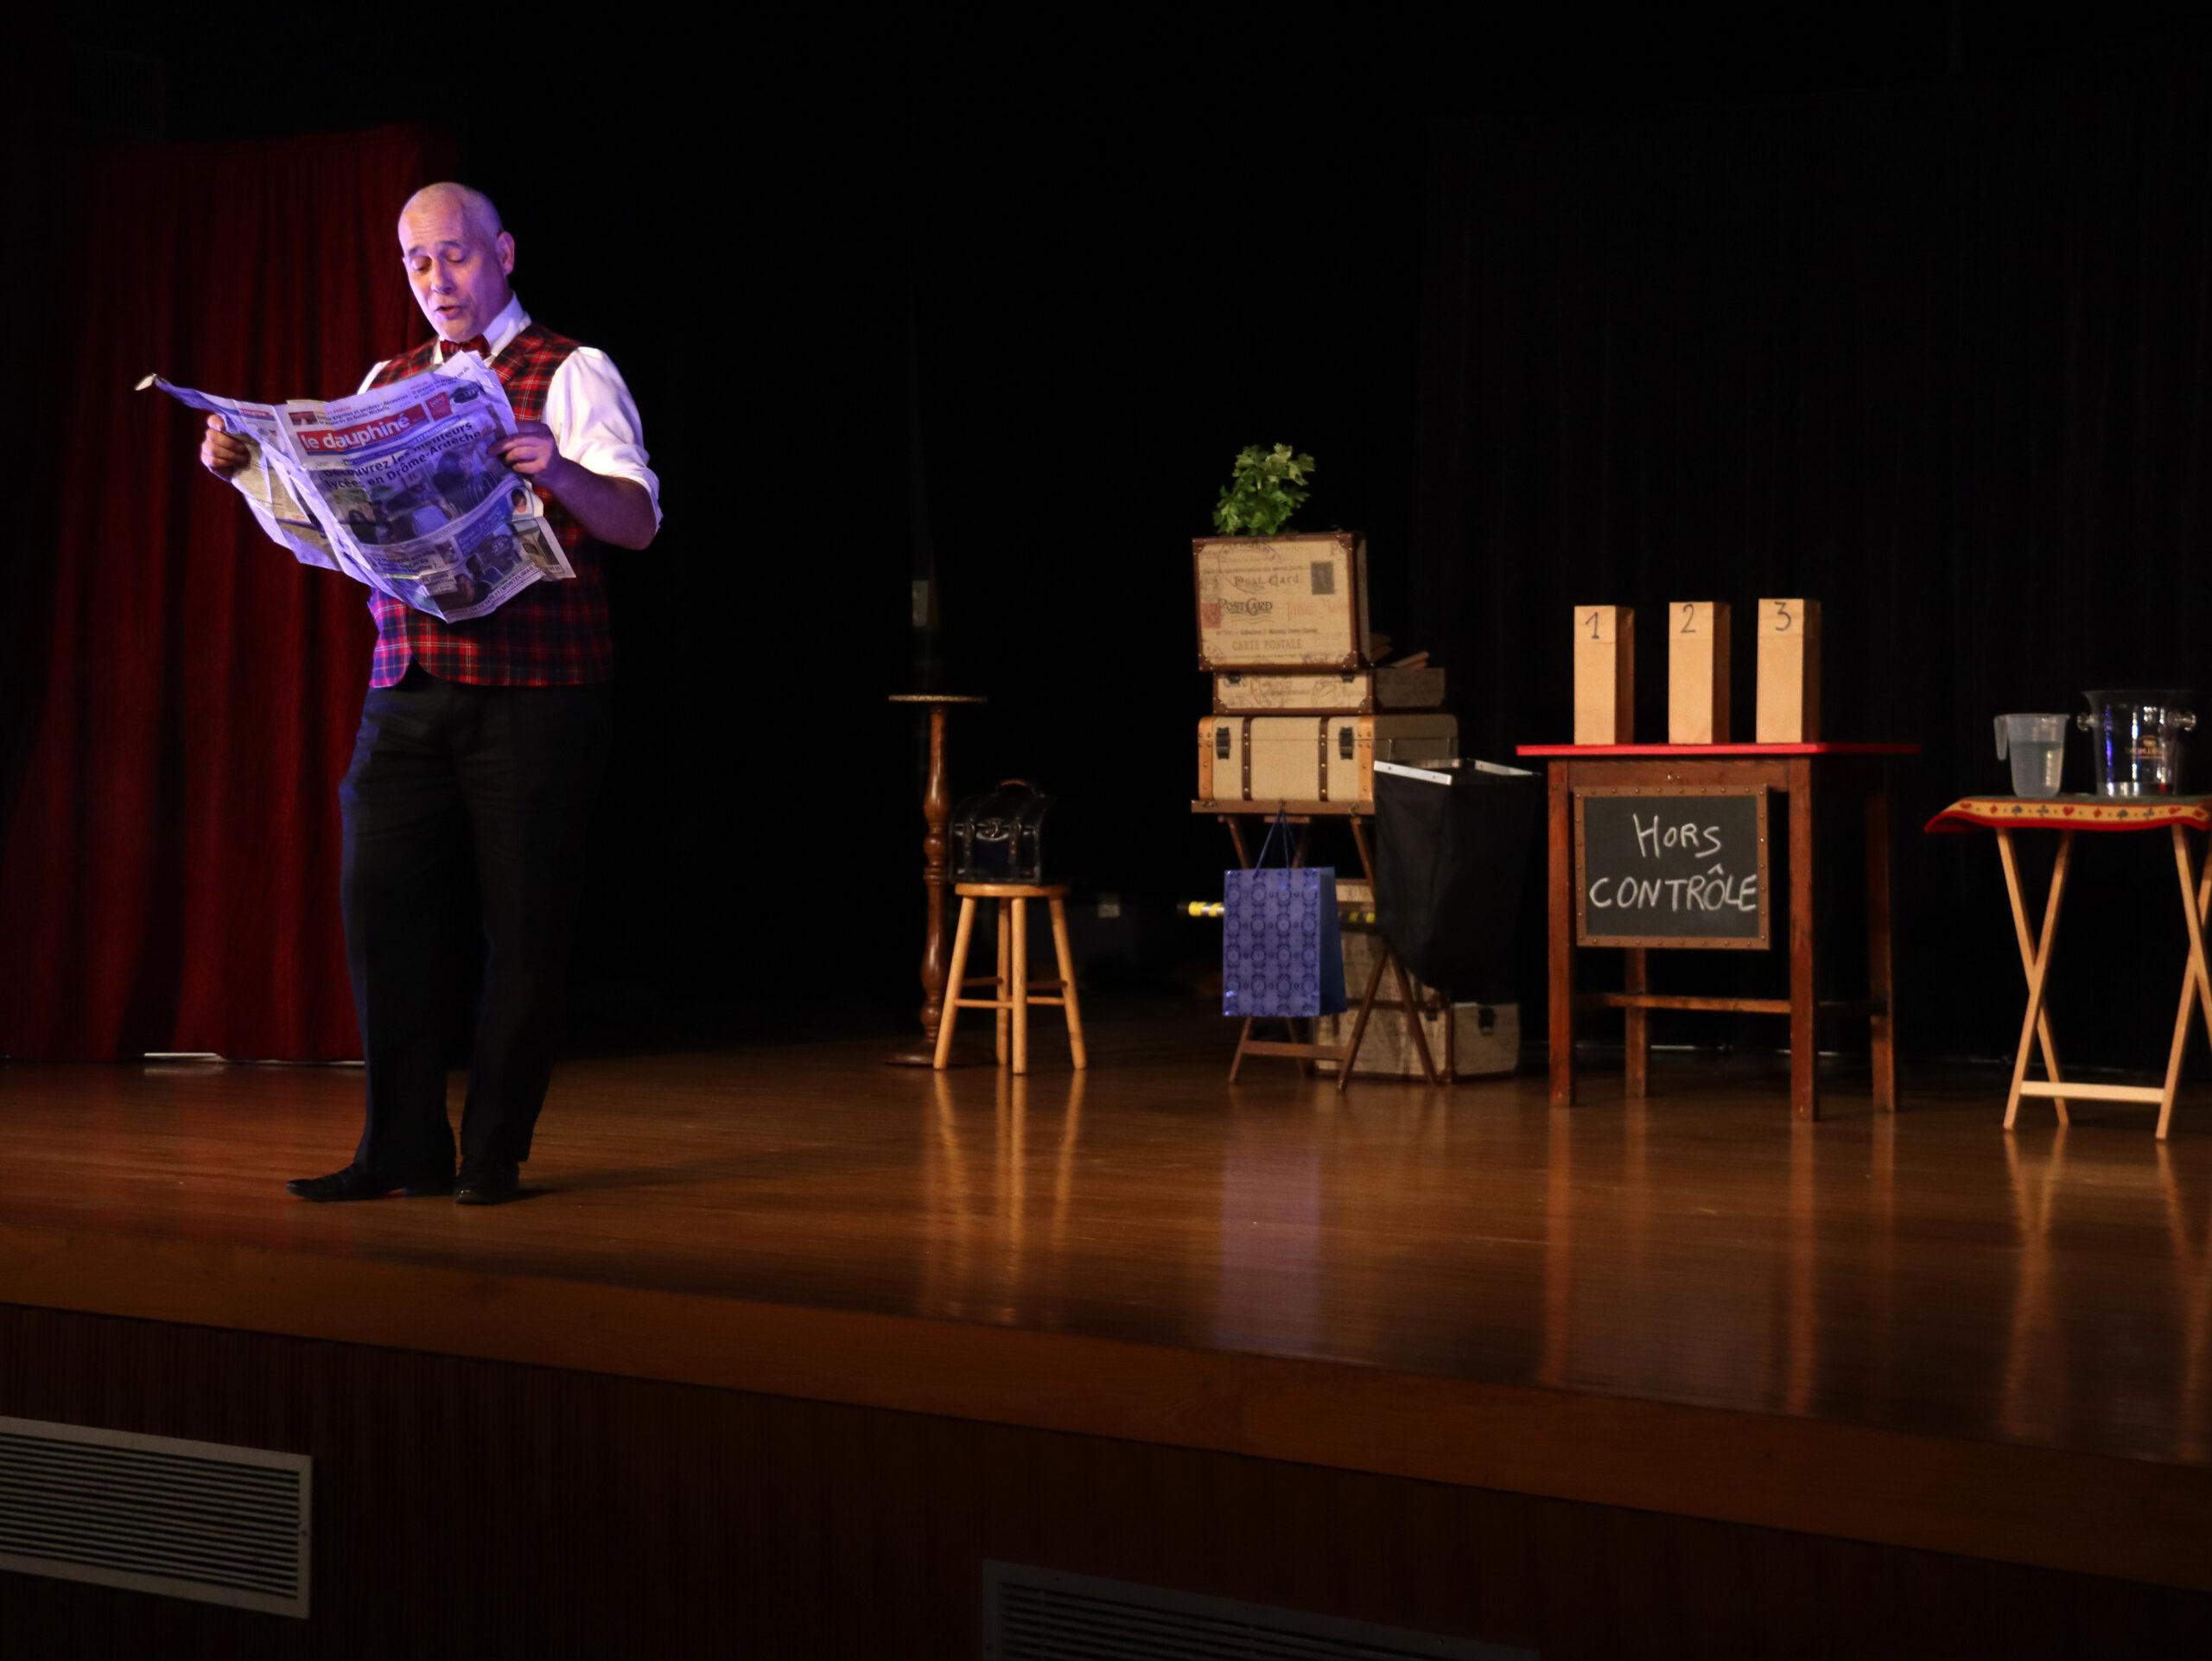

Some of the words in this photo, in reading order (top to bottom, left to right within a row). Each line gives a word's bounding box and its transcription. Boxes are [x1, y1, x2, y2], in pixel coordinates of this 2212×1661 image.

[301, 434, 320, 449] le
[323, 413, 410, 449] dauphiné
[368, 476, 385, 487] en
[1585, 612, 1599, 640] 1
[1681, 603, 1697, 633] 2
[1774, 601, 1793, 632] 3
[1264, 639, 1302, 650] POSTALE
[1632, 813, 1722, 858] HORS
[1588, 863, 1758, 913] CONTRÔLE
